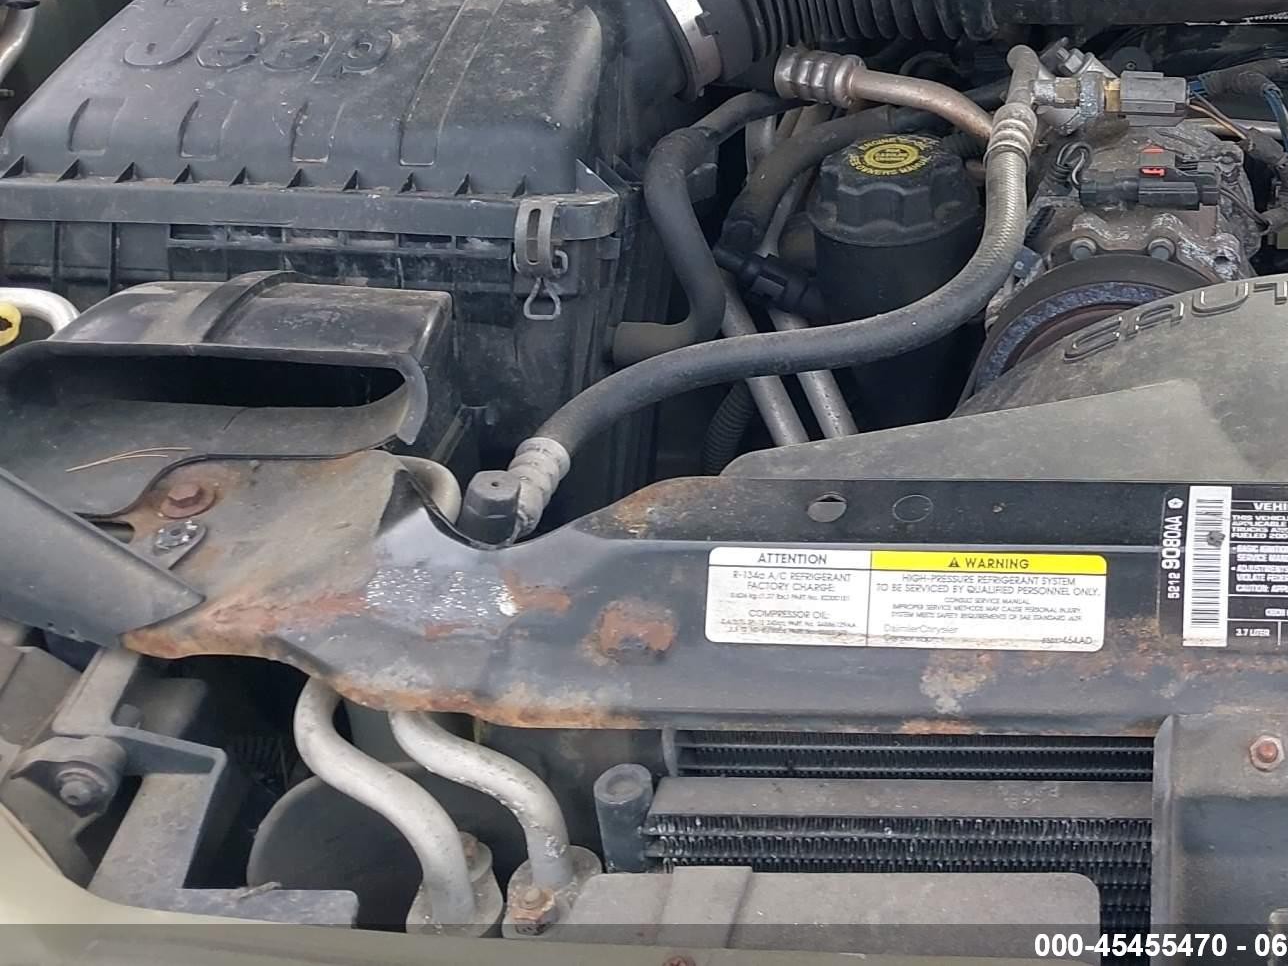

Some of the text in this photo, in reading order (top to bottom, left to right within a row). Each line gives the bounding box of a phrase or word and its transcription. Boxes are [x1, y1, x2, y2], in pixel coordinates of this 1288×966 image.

[120, 19, 400, 84] Jeep
[757, 552, 828, 565] ATTENTION
[964, 557, 1030, 569] WARNING
[1161, 515, 1183, 599] 5212 9080AA
[768, 571, 787, 581] A/C
[790, 572, 852, 582] REFRIGERANT
[902, 574, 1076, 586] HIGH-PRESSURE REFRIGERANT SYSTEM
[747, 581, 788, 591] FACTORY
[876, 583, 1101, 596] TO BE SERVICED BY QUALIFIED PERSONNEL ONLY.
[748, 609, 810, 619] COMPRESSOR
